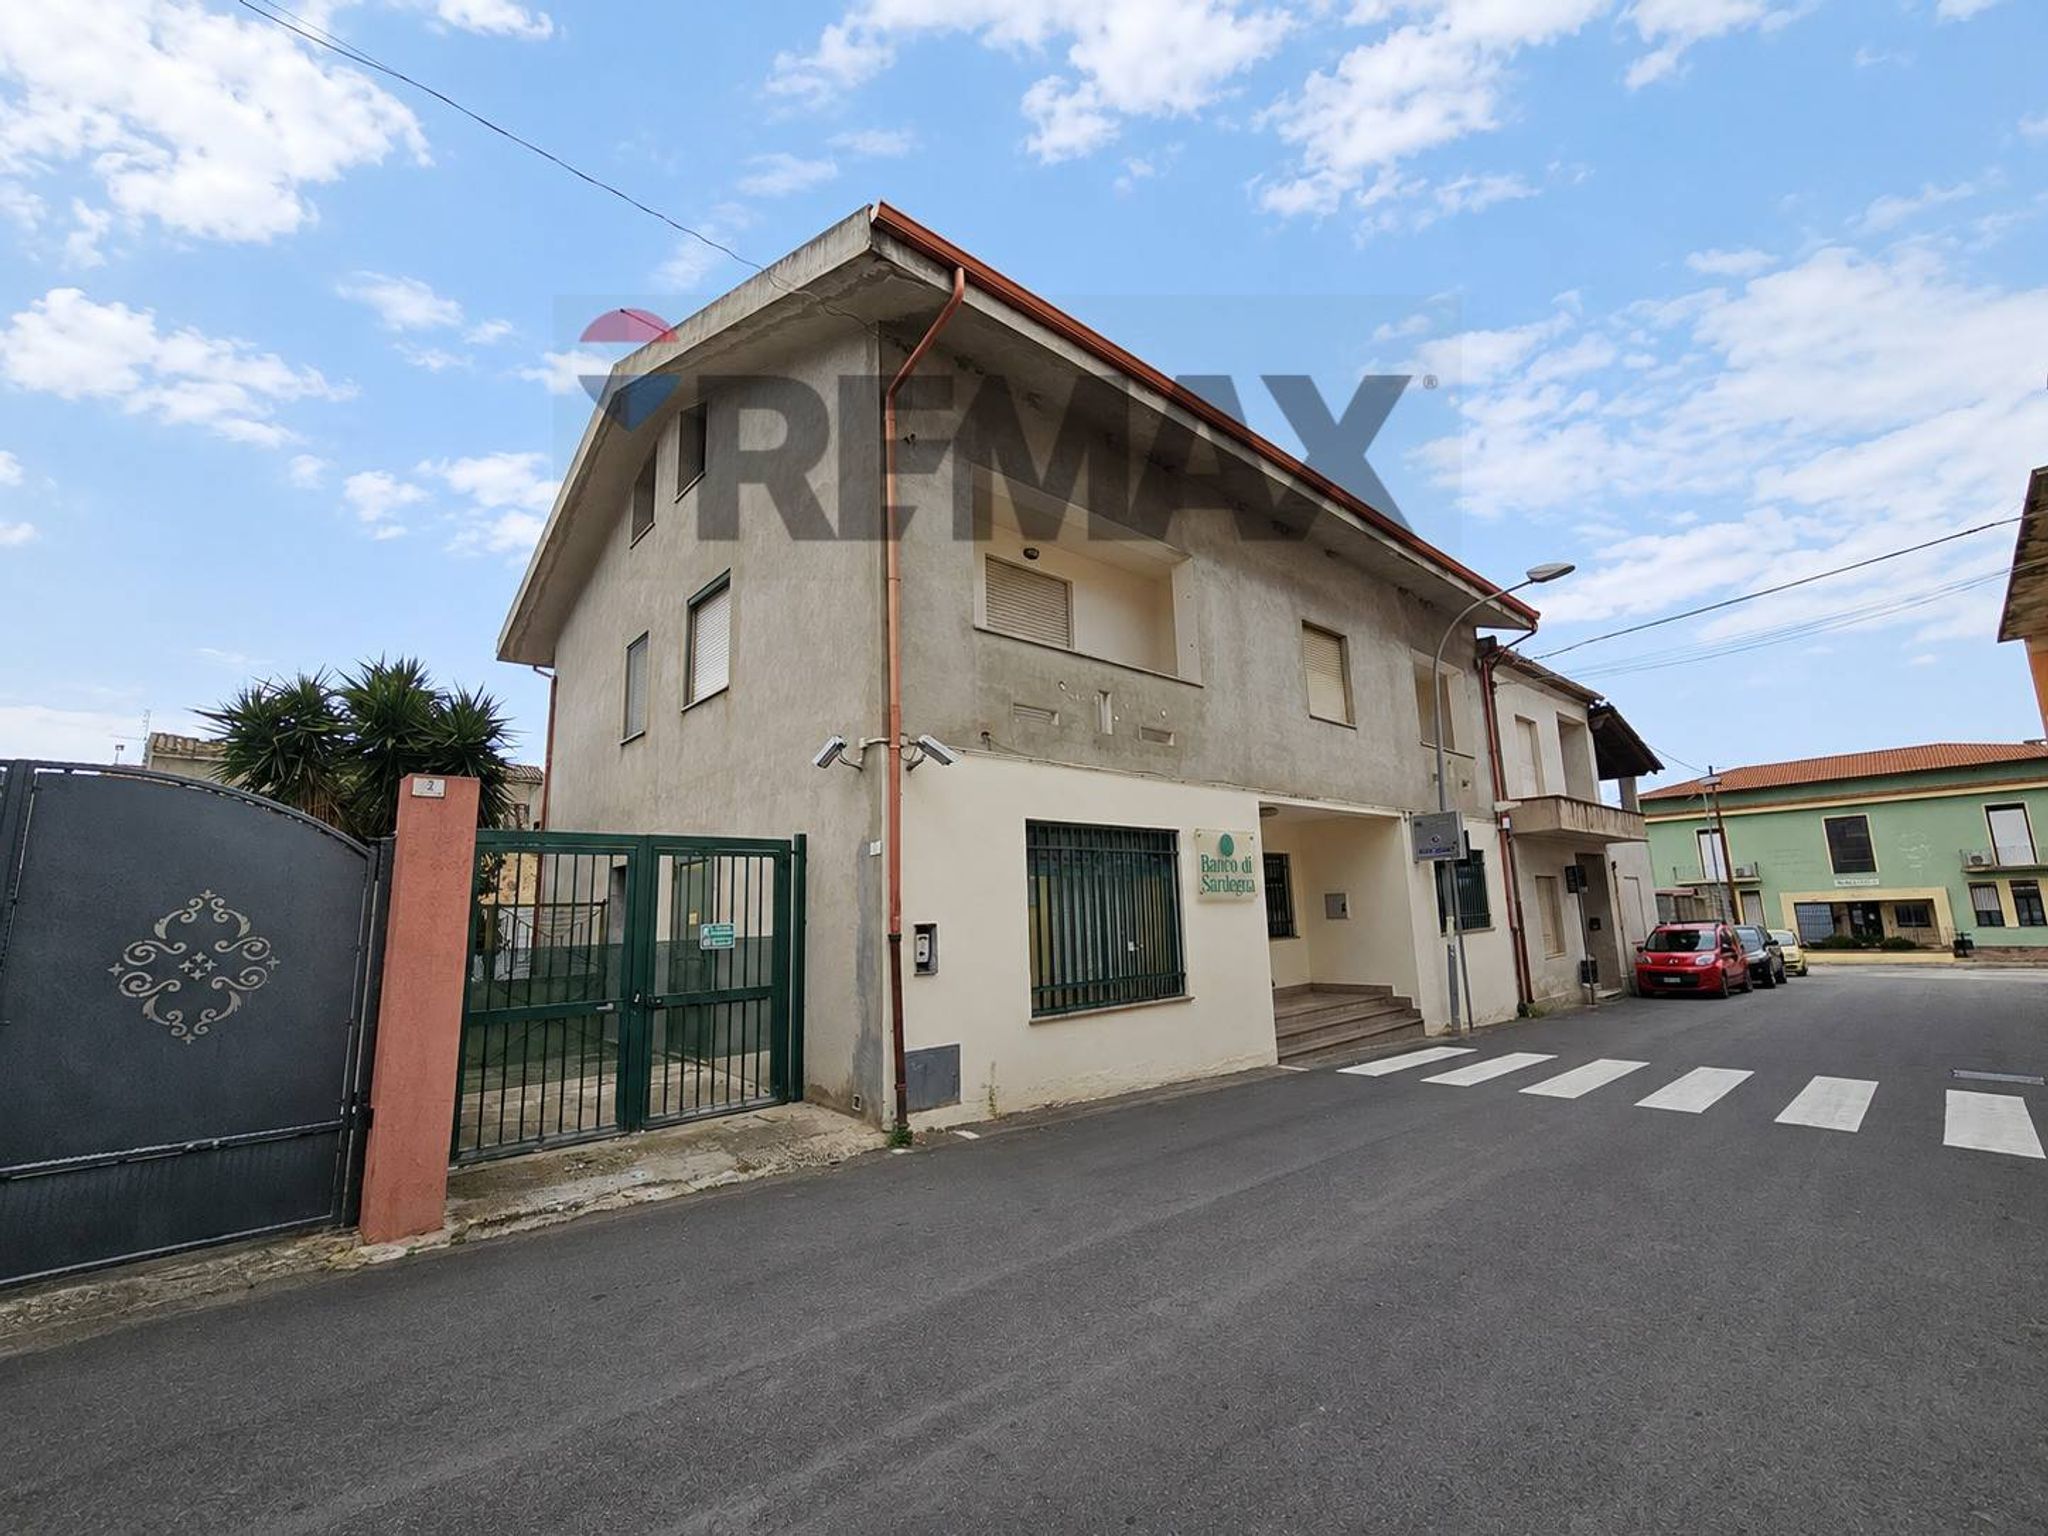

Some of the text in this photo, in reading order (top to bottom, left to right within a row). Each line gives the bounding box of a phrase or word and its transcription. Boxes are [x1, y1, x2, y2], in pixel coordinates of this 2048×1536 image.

[1201, 854, 1253, 873] Banco di
[1202, 874, 1256, 896] Sardegna
